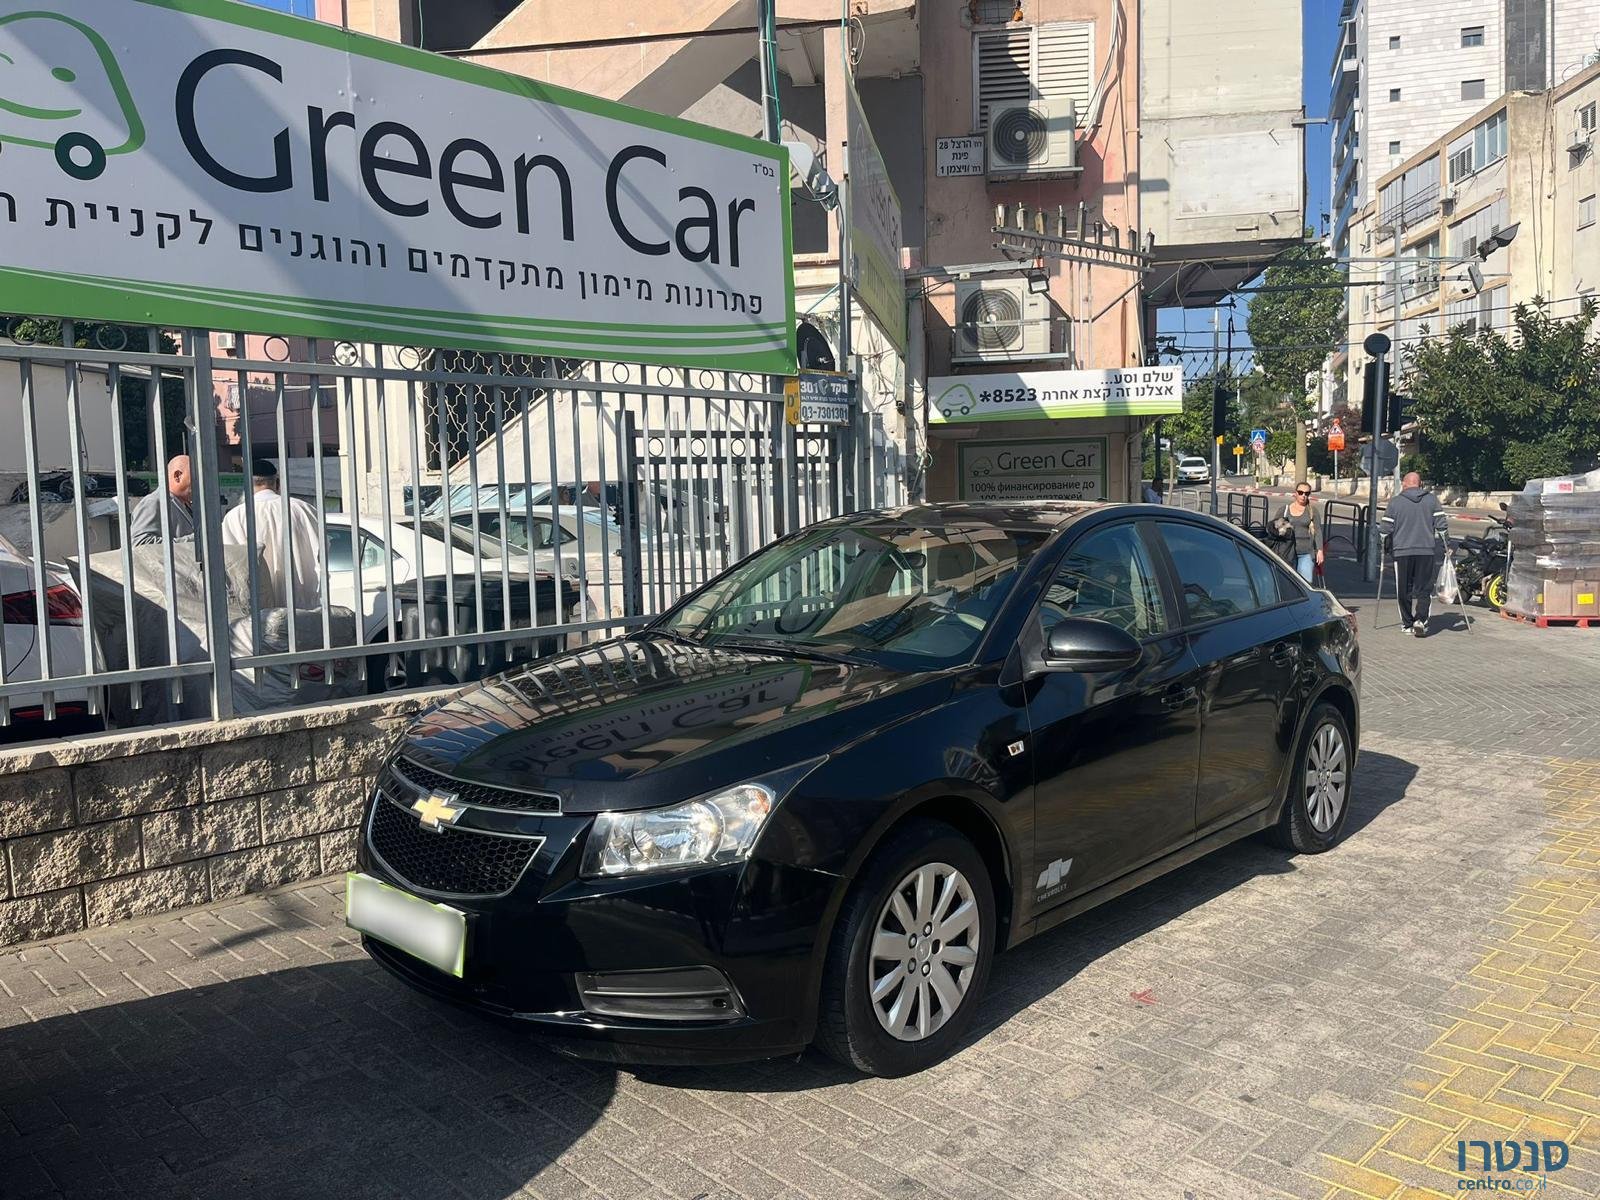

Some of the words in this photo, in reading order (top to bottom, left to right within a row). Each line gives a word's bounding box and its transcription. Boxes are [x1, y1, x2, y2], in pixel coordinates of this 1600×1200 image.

[939, 141, 949, 149] 28
[950, 139, 972, 149] הרצל
[175, 48, 575, 242] Green
[605, 144, 755, 268] Car
[951, 152, 969, 161] פינת
[752, 163, 775, 177] בס"ד
[940, 165, 945, 174] 1
[44, 197, 213, 249] לקניית
[238, 223, 387, 268] והוגנים
[407, 246, 564, 290] מתקדמים
[578, 270, 653, 301] מימון
[664, 282, 762, 315] פתרונות
[1100, 373, 1137, 385] וסע...
[1143, 370, 1173, 383] שלם
[800, 381, 819, 394] 301
[1083, 387, 1111, 401] קצת
[1116, 387, 1131, 397] זה
[1136, 384, 1174, 397] אצלנו
[1042, 389, 1079, 401] אחרת
[801, 405, 848, 420] 03-7301301
[997, 451, 1056, 471] Green
[1061, 449, 1096, 468] Car
[970, 482, 996, 493] 100%
[997, 480, 1080, 496] финансирование
[1082, 480, 1095, 491] до
